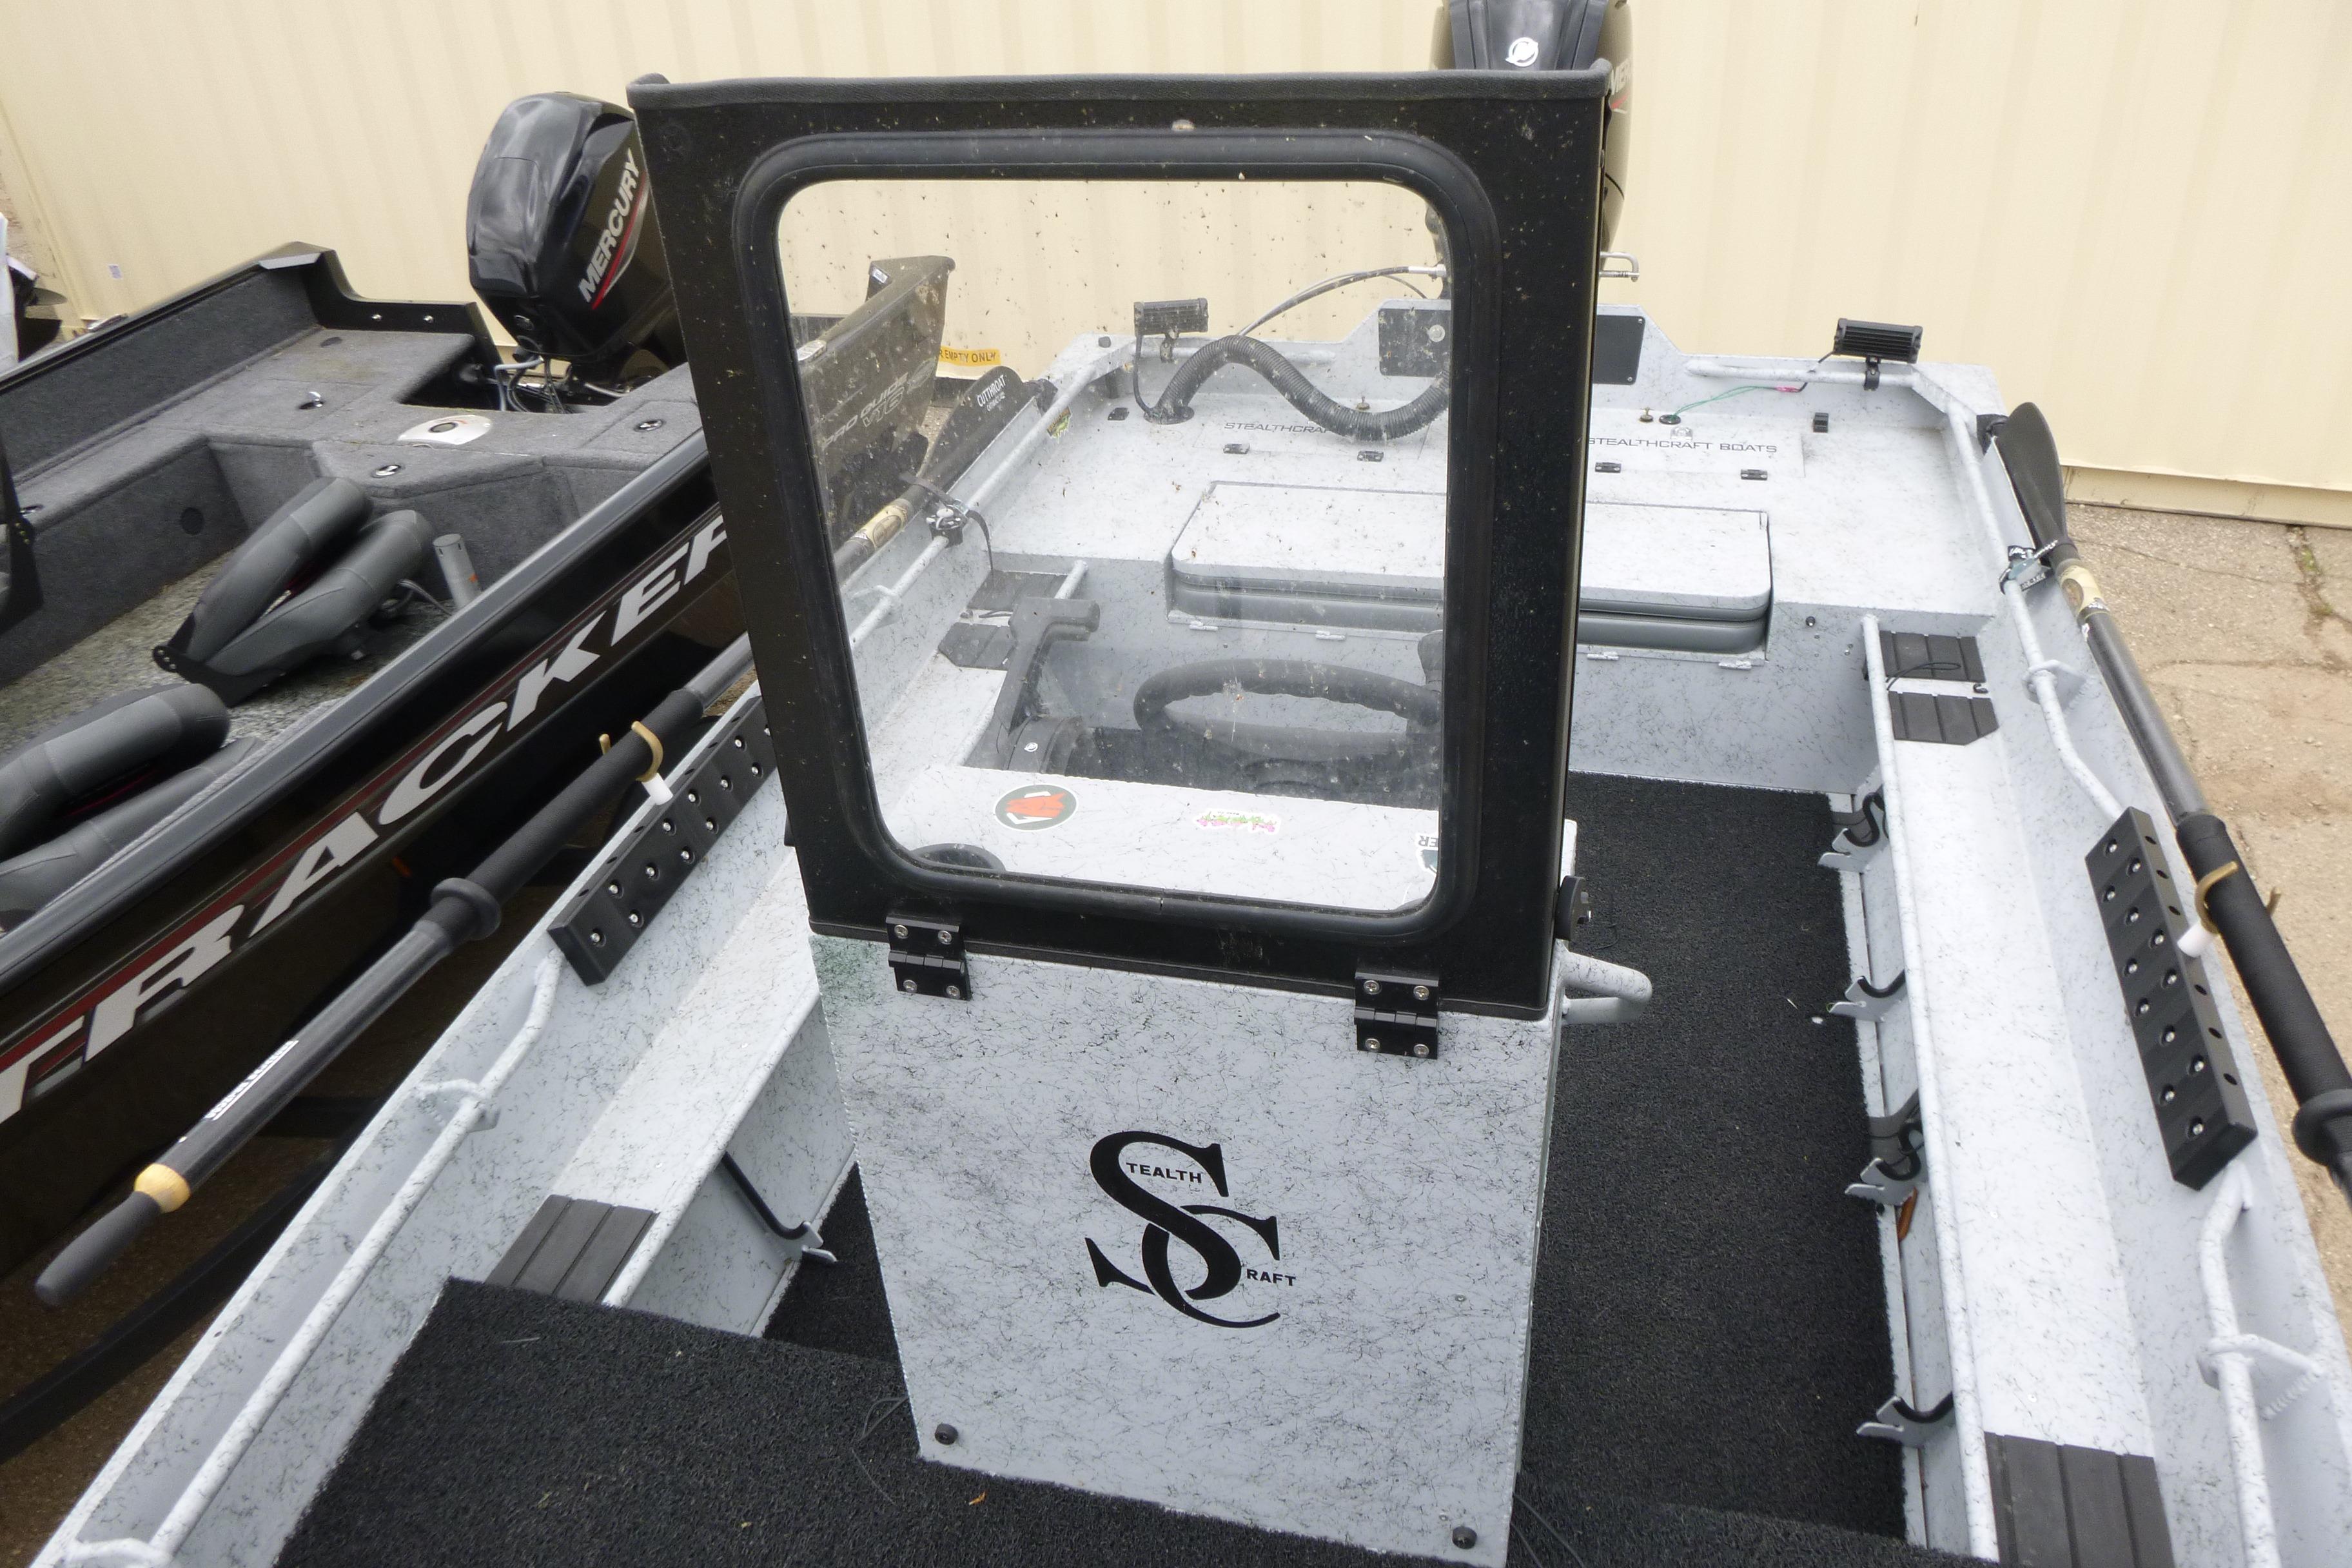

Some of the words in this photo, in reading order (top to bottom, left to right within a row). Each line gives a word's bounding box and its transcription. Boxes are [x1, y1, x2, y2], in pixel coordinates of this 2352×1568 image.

[578, 148, 639, 303] MERCURY
[945, 349, 969, 363] EMPTY
[971, 352, 996, 363] ONLY
[977, 375, 1006, 407] CUTTHROAT
[1224, 422, 1326, 433] STEALTHCRA
[1589, 437, 1712, 449] STEALTHCRAFT
[1720, 443, 1777, 453] BOATS
